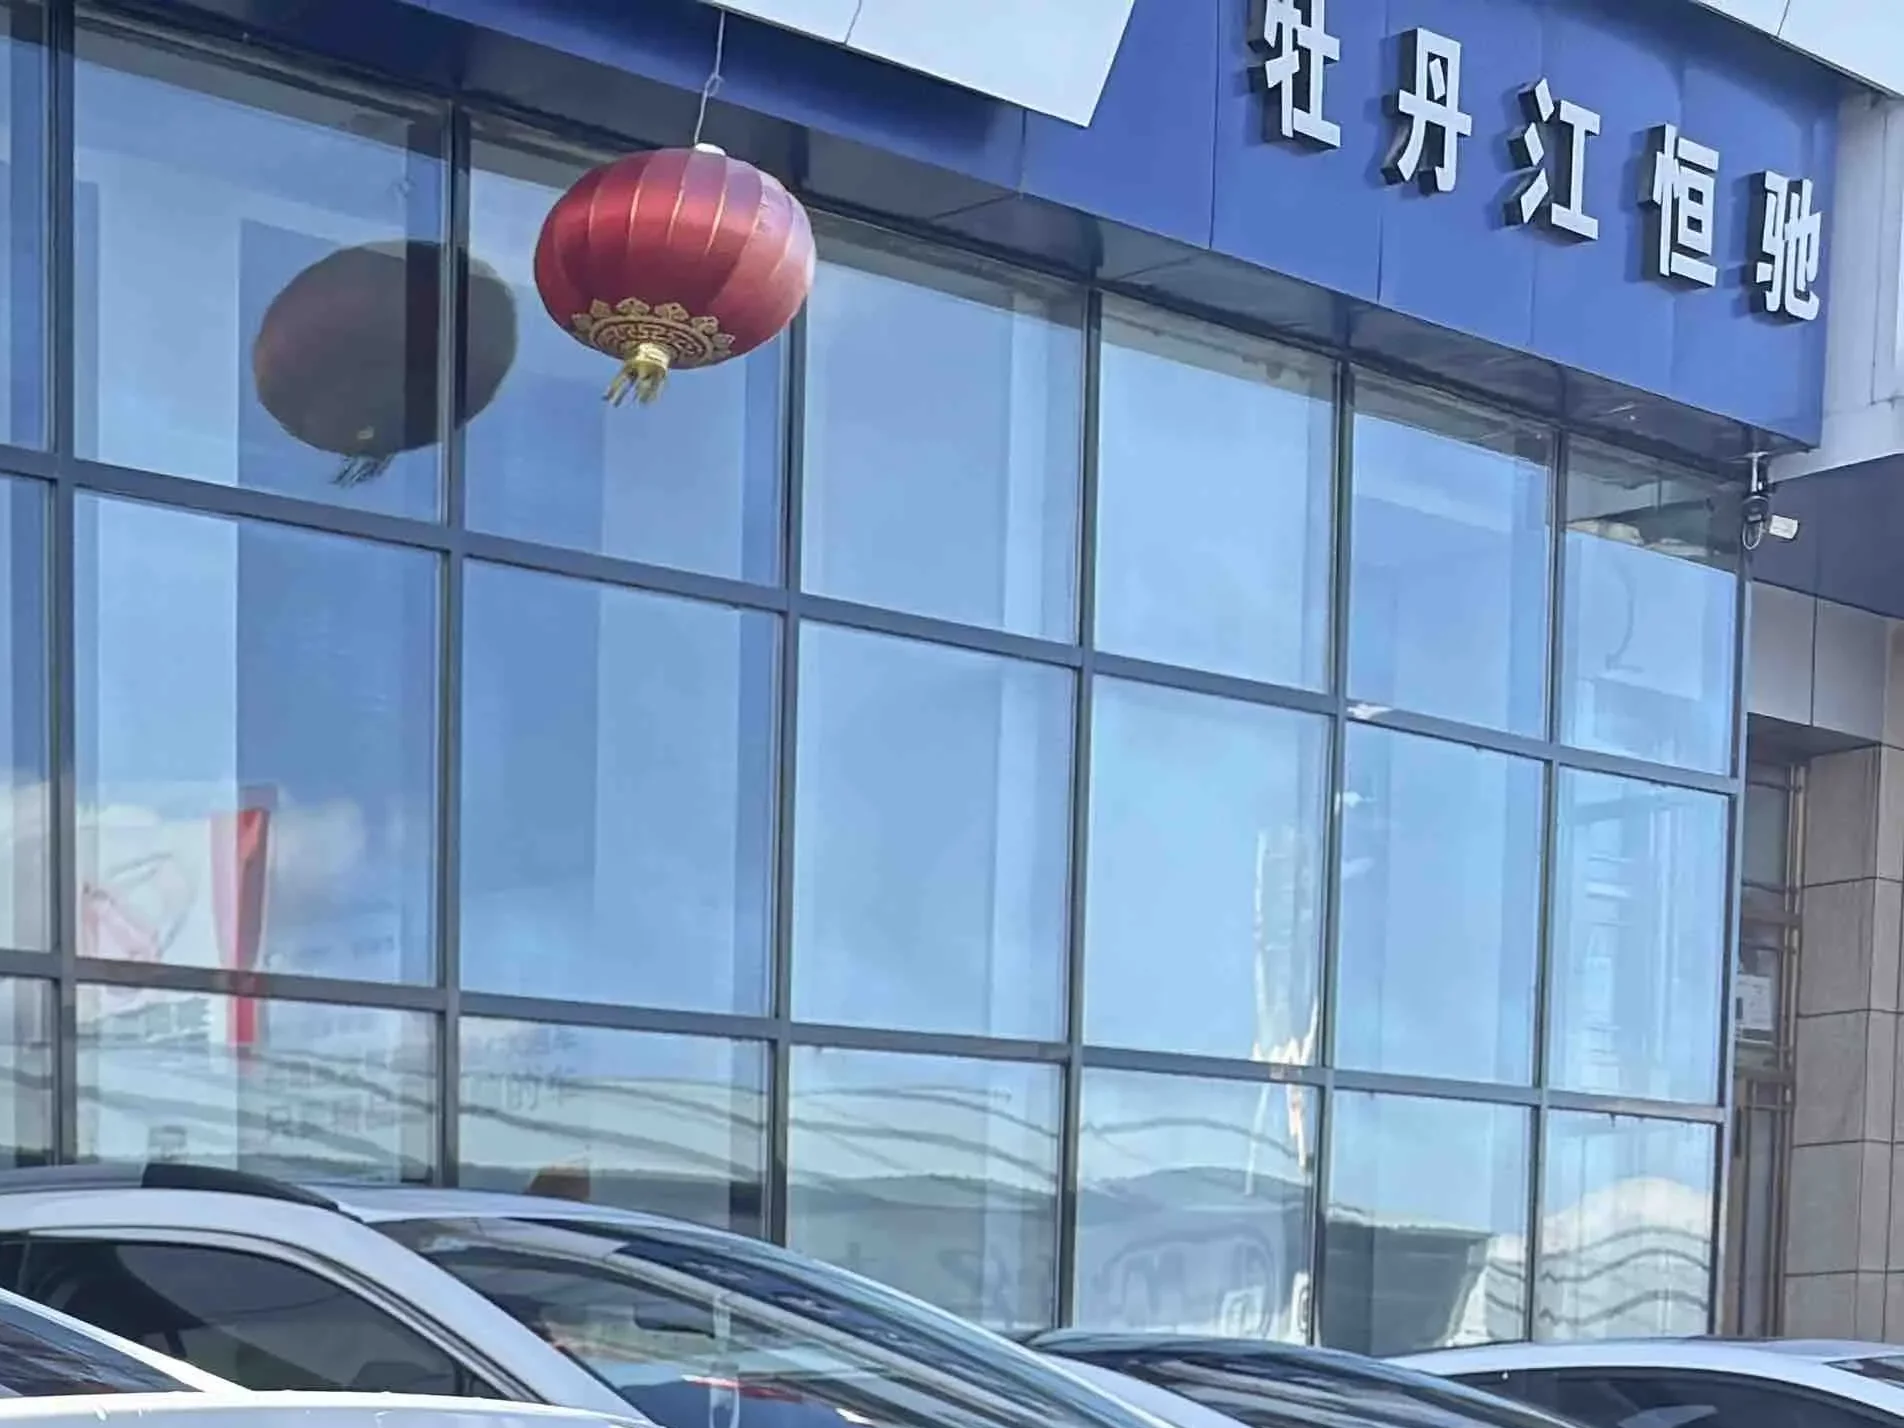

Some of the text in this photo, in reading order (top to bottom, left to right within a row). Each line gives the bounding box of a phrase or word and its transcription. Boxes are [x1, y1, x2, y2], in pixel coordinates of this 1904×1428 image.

[1248, 0, 1823, 321] 牡丹江恒驰
